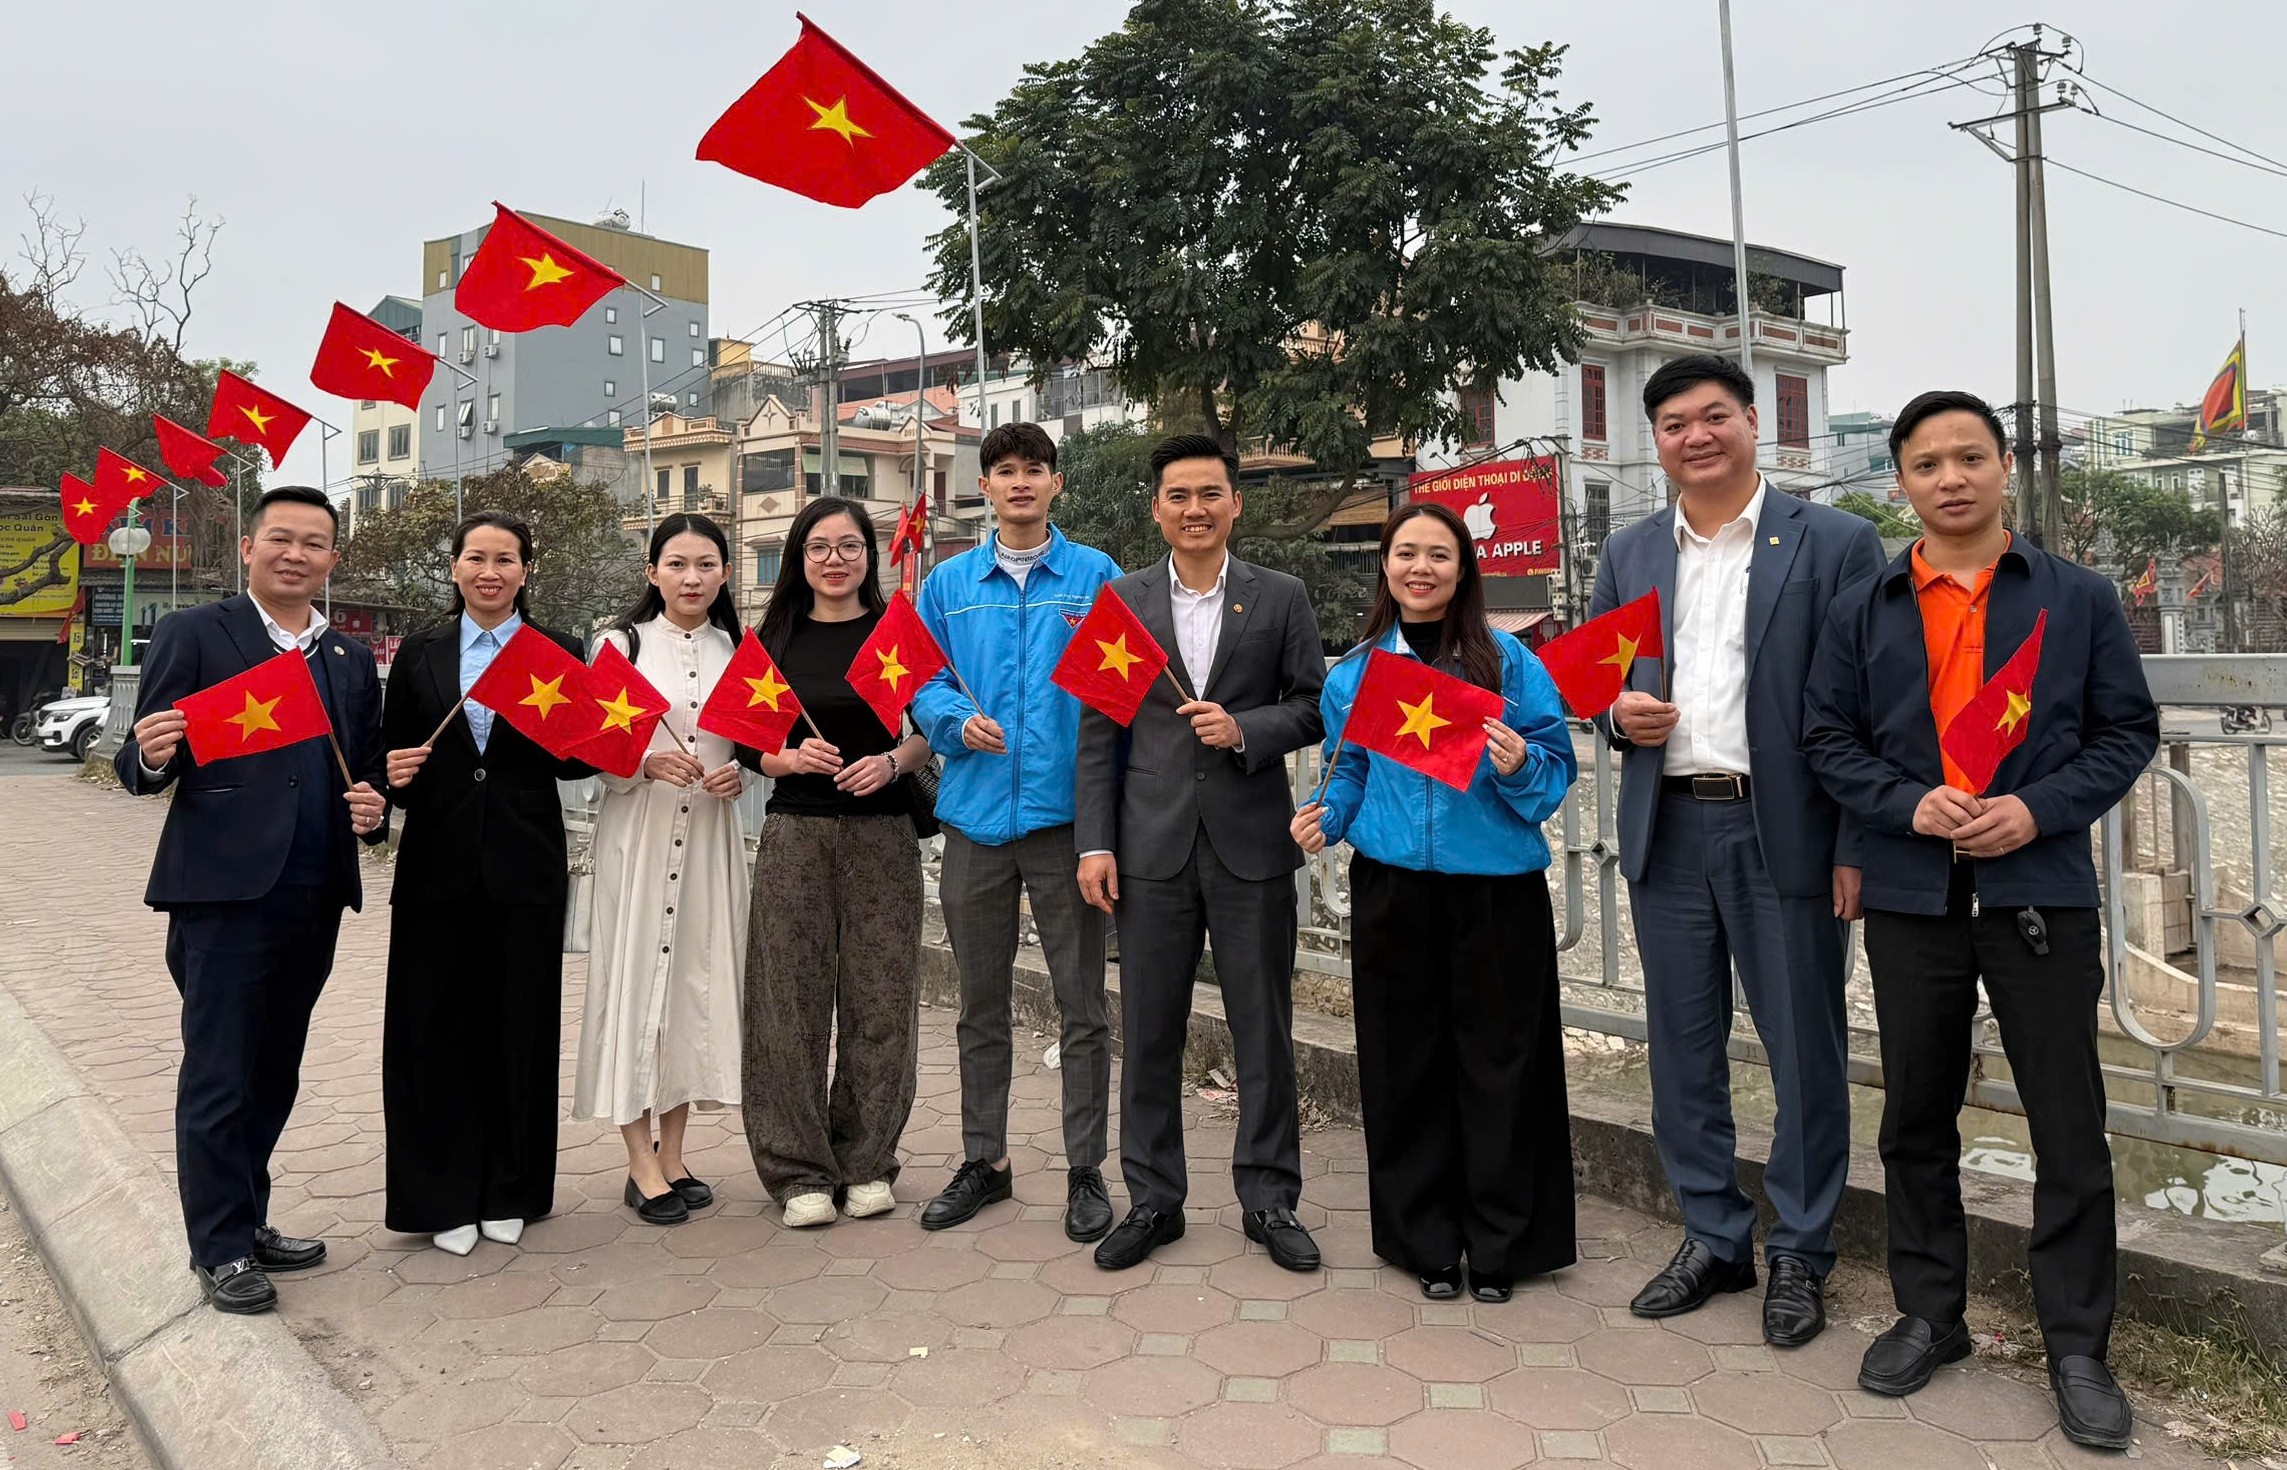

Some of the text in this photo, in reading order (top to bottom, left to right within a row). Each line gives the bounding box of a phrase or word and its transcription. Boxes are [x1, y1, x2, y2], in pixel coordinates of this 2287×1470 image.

[1453, 474, 1476, 492] ĐIỆN
[1478, 471, 1508, 487] THOẠI
[1510, 470, 1520, 483] DI
[1492, 540, 1542, 558] APPLE
